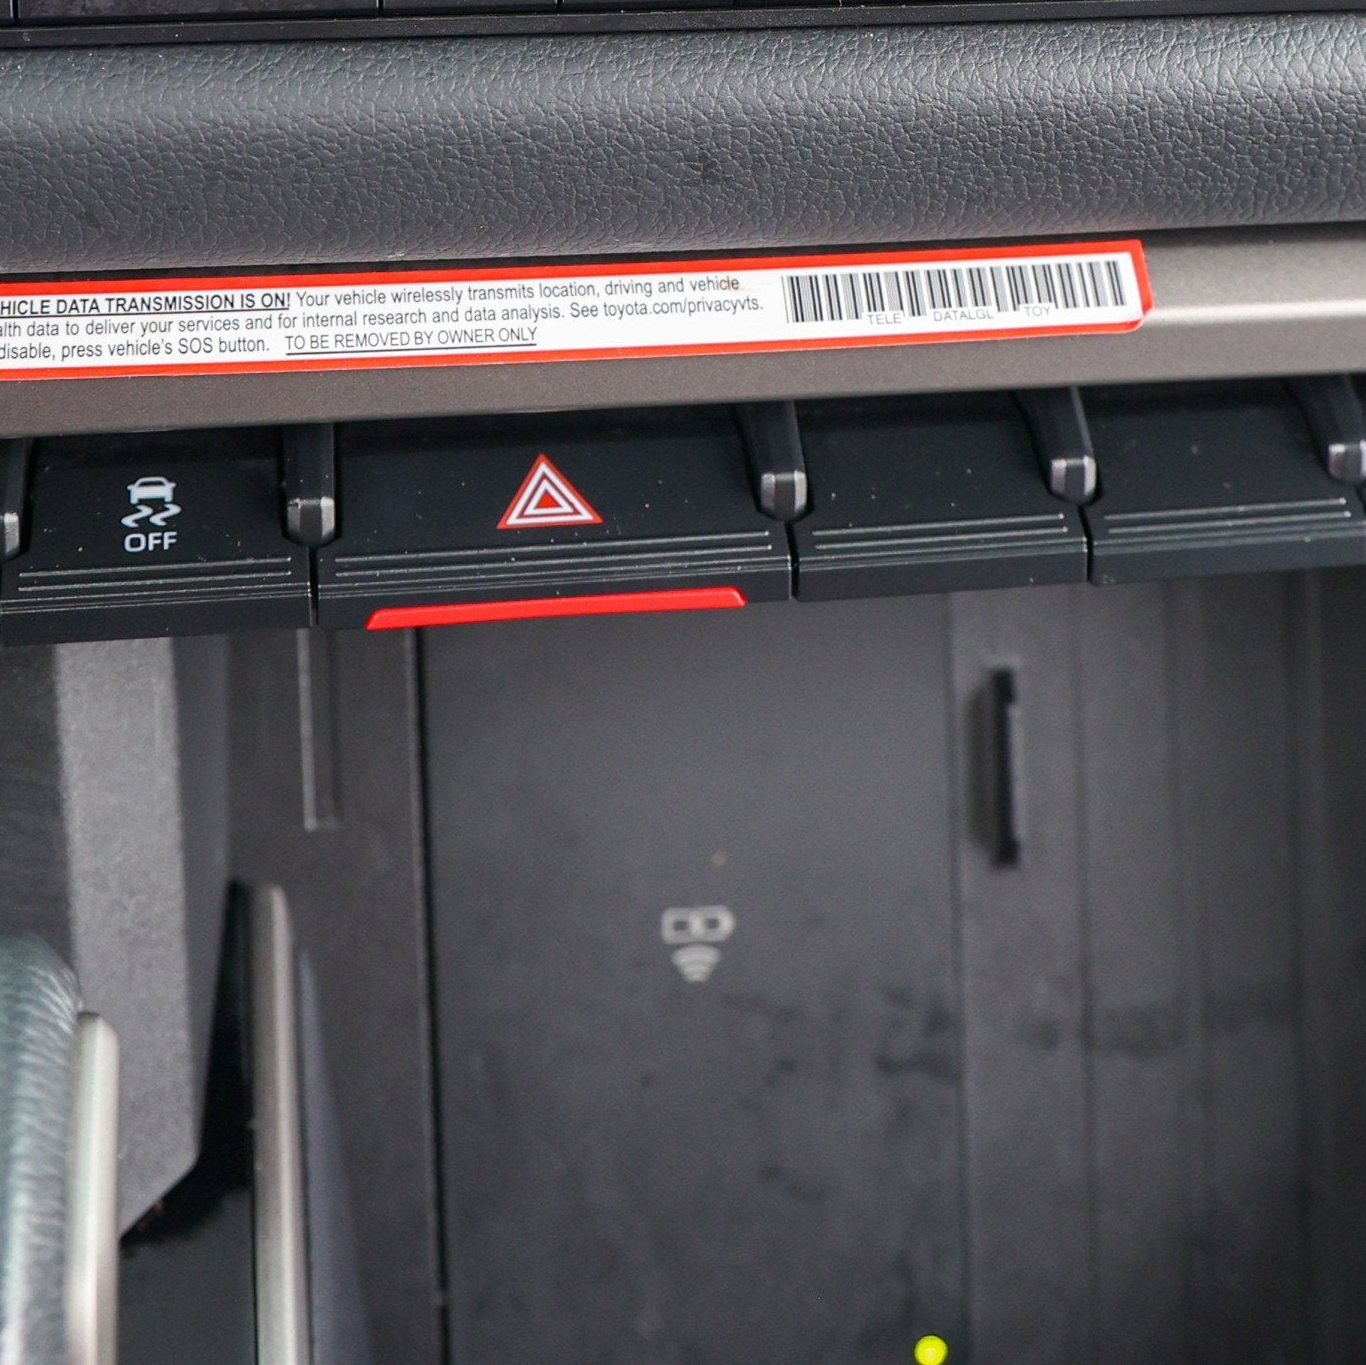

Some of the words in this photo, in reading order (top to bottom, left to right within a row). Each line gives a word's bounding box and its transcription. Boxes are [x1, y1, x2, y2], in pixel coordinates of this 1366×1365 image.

[57, 298, 101, 314] DATA
[106, 294, 235, 313] TRANSMISSION
[241, 293, 255, 308] IS
[261, 292, 291, 308] ON!
[296, 291, 330, 306] Your
[335, 289, 386, 305] vehicle
[391, 286, 463, 305] wirelessly
[468, 284, 534, 300] transmits
[539, 281, 600, 298] location,
[605, 279, 652, 297] driving
[658, 277, 684, 293] and
[690, 276, 740, 292] vehicle
[27, 321, 59, 337] data
[66, 320, 79, 336] to
[86, 319, 136, 334] deliver
[140, 320, 174, 337] your
[178, 316, 240, 332] services
[245, 314, 273, 330] and
[278, 313, 298, 329] for
[302, 311, 357, 328] internal
[363, 308, 427, 325] research
[432, 307, 459, 323] and
[464, 306, 497, 322] data
[501, 303, 565, 323] analysis.
[570, 302, 599, 318] See
[603, 295, 764, 320] toyota.com/privacyvts.
[867, 312, 902, 325] TELE
[1024, 305, 1052, 318] TOY
[61, 344, 103, 362] press
[108, 339, 173, 356] vehicle's
[178, 337, 213, 355] SOS
[218, 337, 270, 354] button.
[285, 335, 306, 350] TO
[310, 334, 329, 350] BE
[335, 331, 410, 348] REMOVED
[414, 330, 434, 345] BY
[438, 328, 495, 344] OWNER
[499, 326, 538, 342] ONLY
[123, 531, 177, 553] OFF
